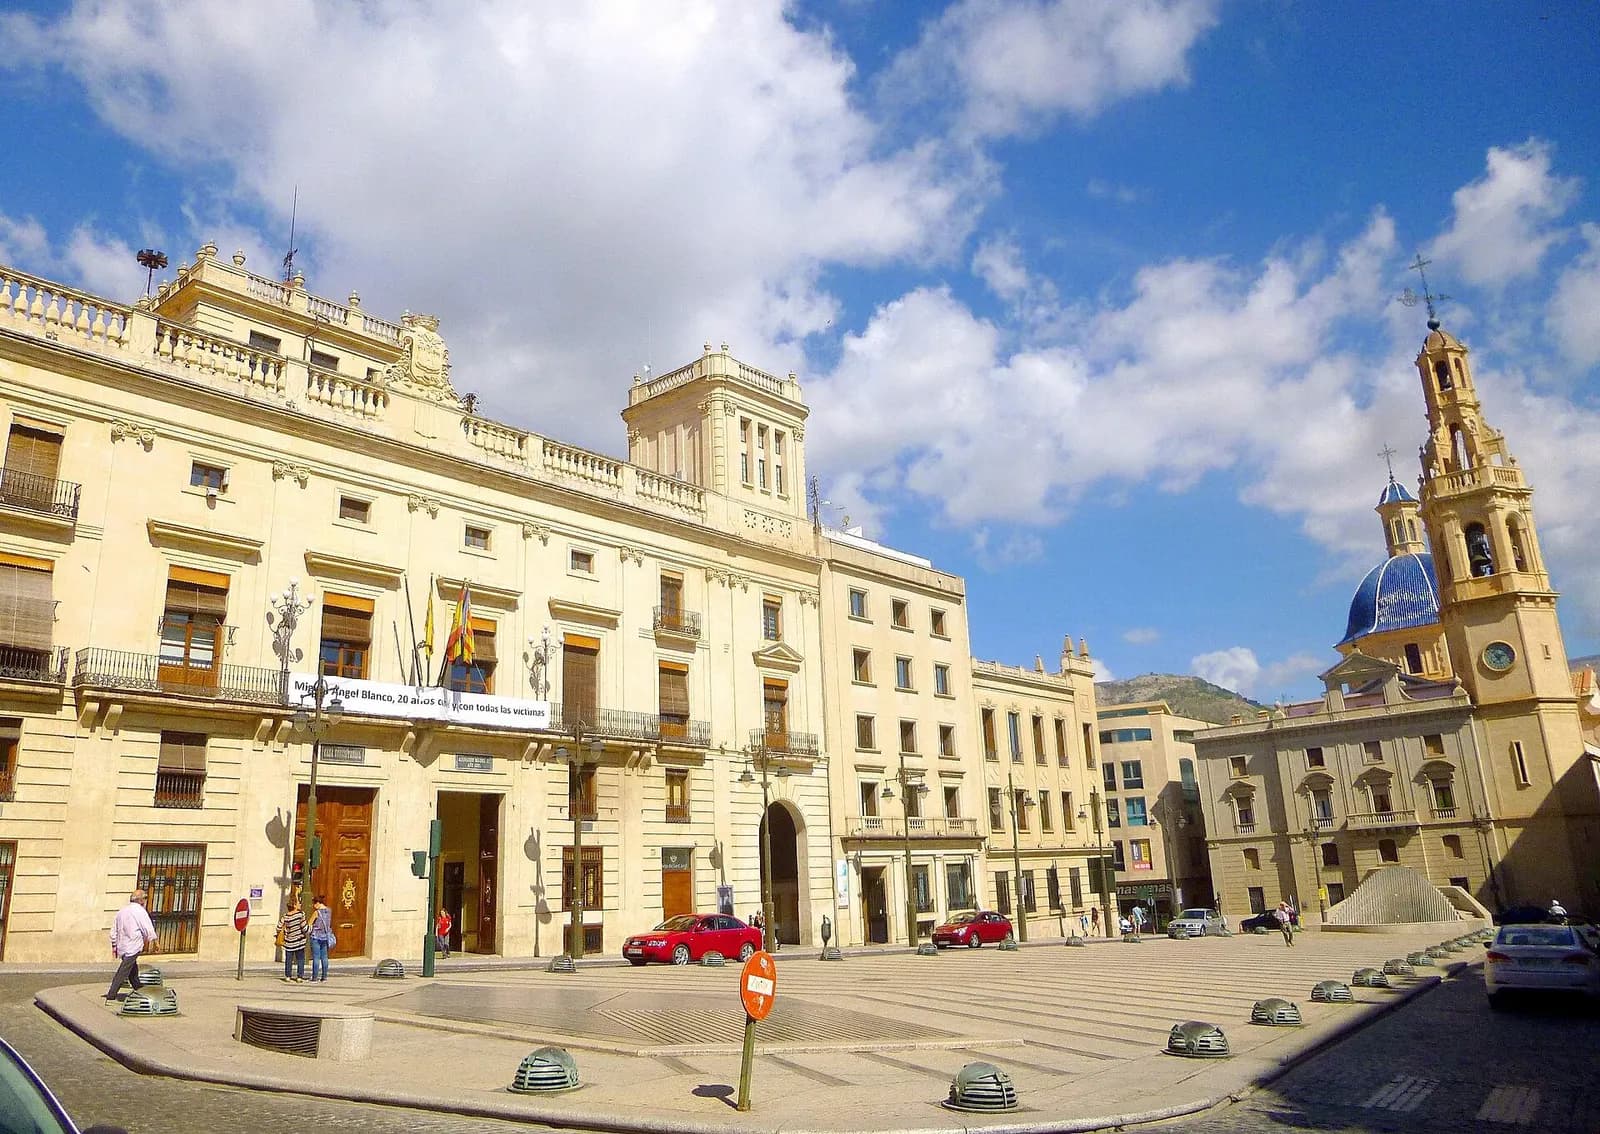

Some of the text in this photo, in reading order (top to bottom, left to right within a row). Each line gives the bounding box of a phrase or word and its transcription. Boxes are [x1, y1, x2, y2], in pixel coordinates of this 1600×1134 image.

[361, 690, 395, 704] Blanco,
[397, 695, 409, 704] 20
[458, 703, 474, 711] con
[476, 704, 499, 714] todas
[500, 705, 512, 714] las
